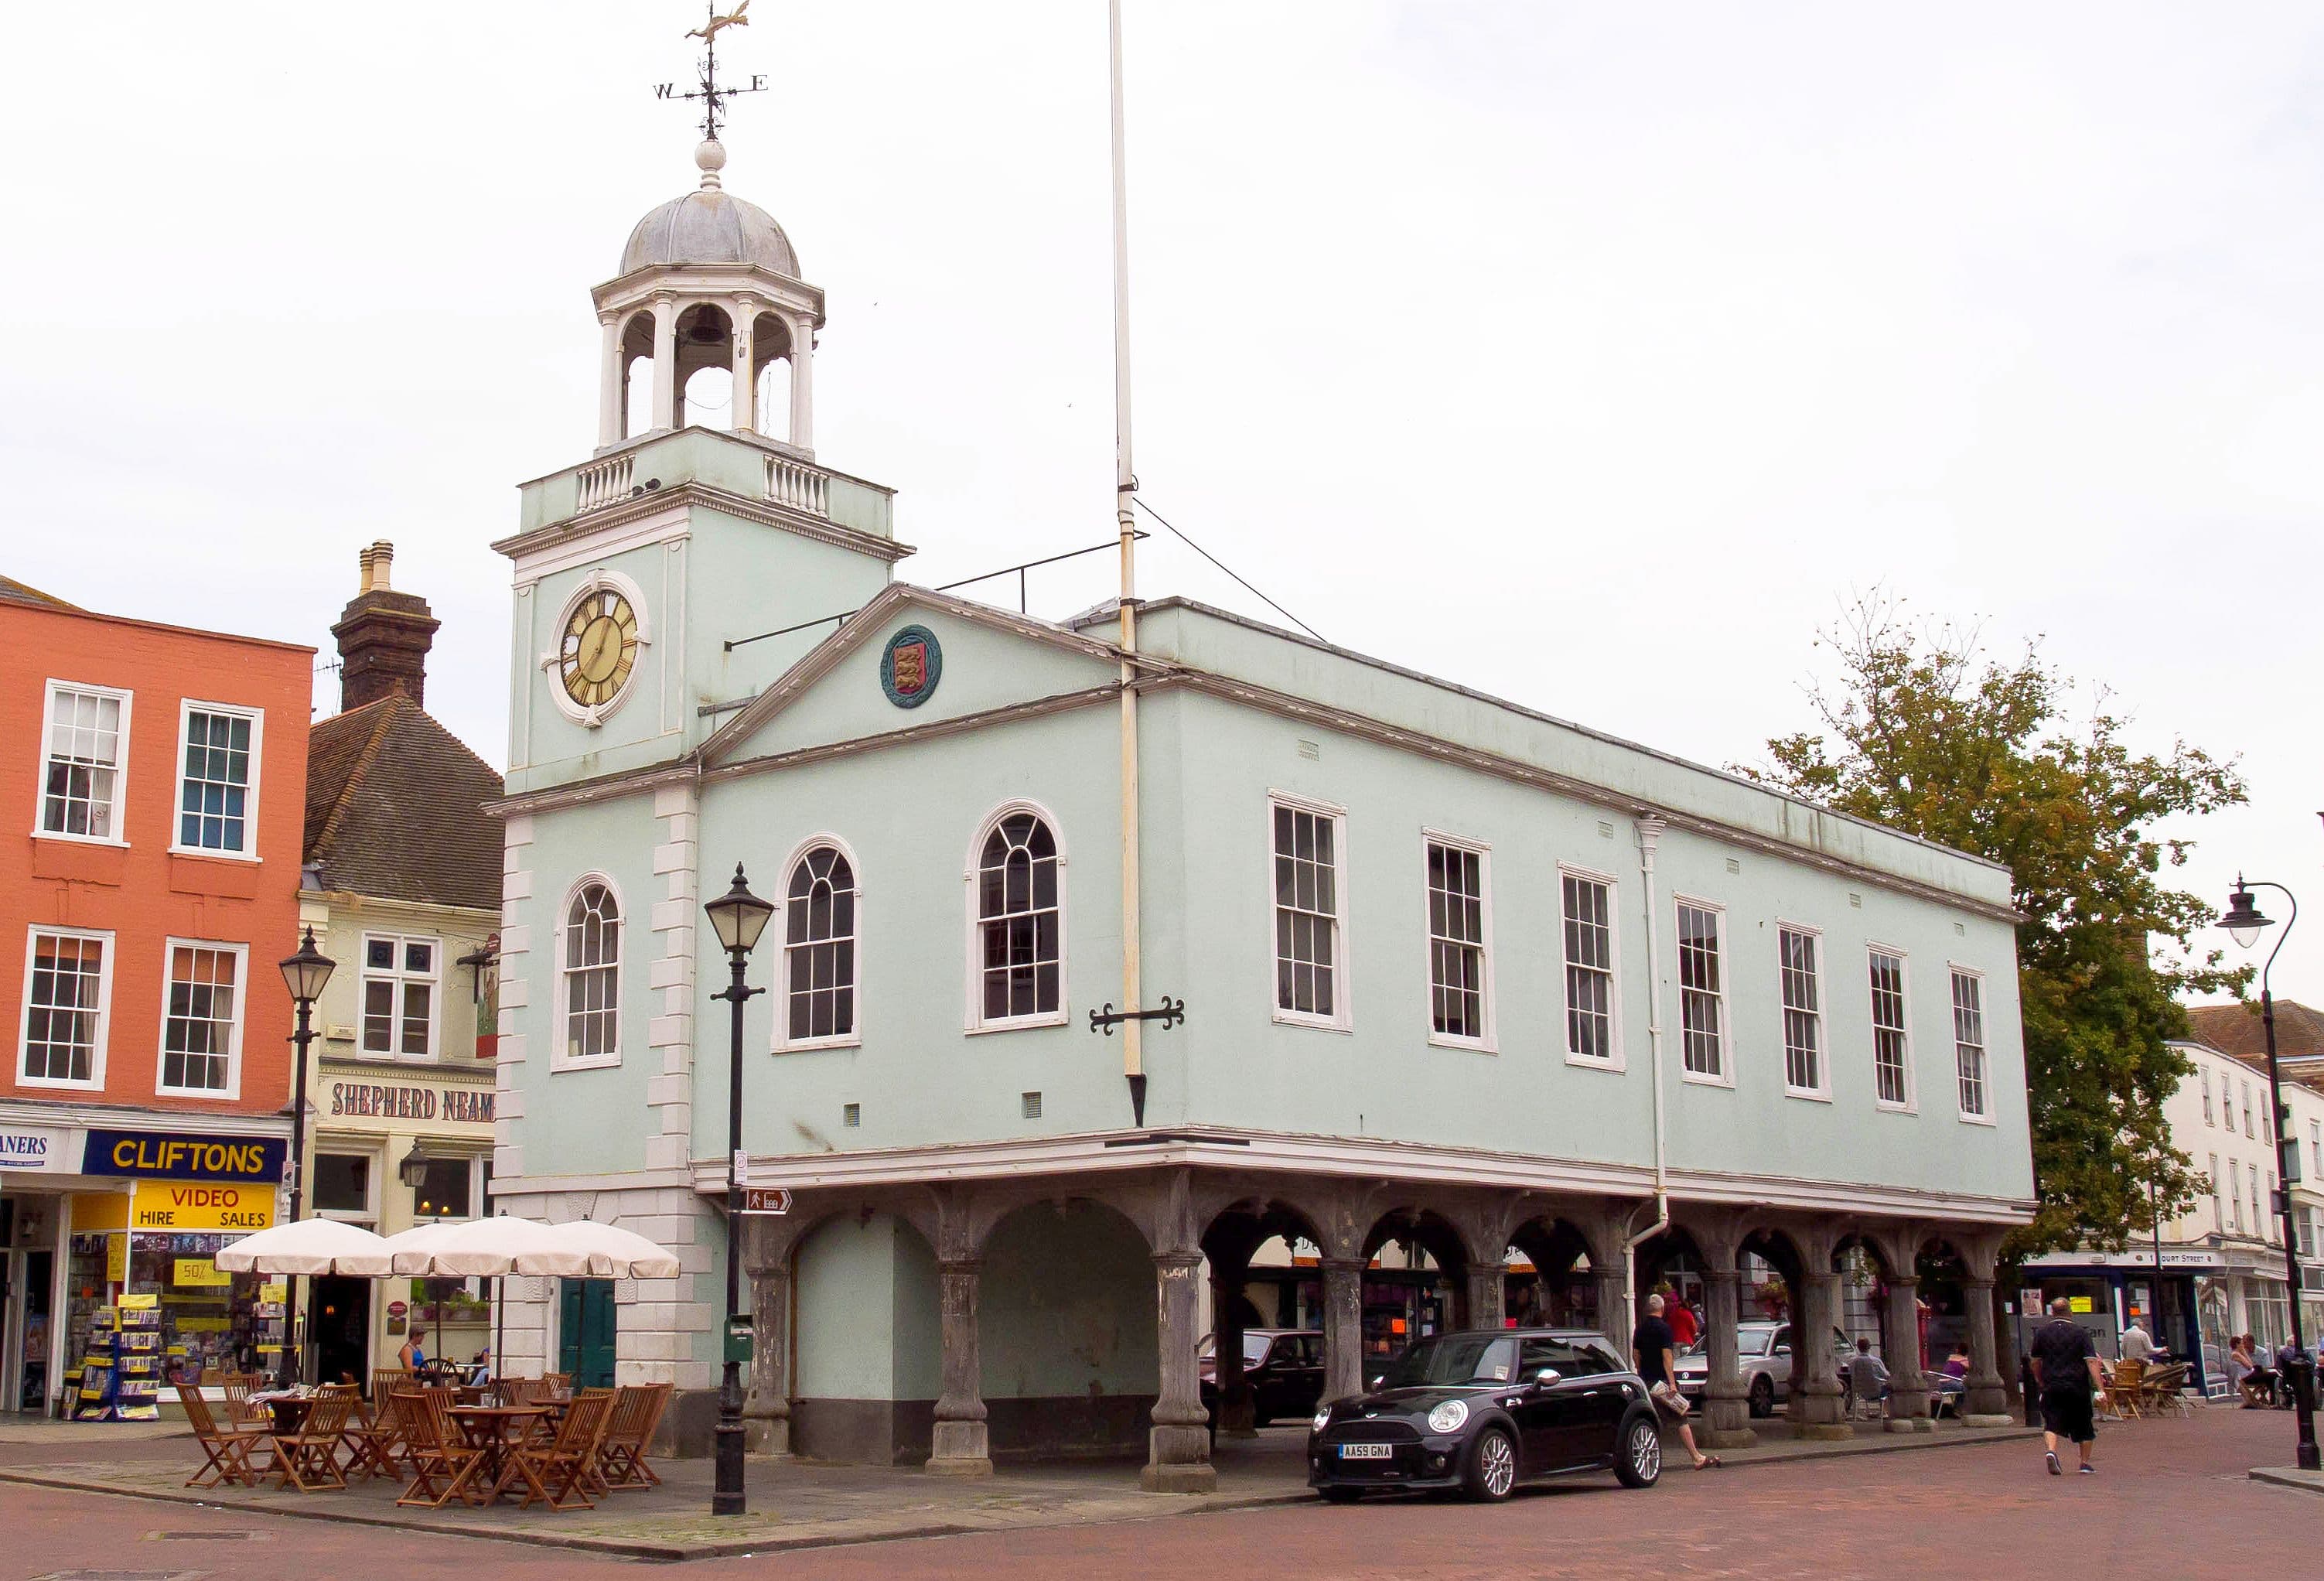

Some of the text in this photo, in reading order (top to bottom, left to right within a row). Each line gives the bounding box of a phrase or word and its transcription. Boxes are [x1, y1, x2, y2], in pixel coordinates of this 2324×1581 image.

[654, 82, 674, 100] W
[750, 74, 769, 91] E
[331, 1082, 437, 1120] SHEPHERD
[112, 1139, 266, 1174] CLIFTONS
[171, 1187, 240, 1207] VIDEO
[140, 1211, 266, 1227] HIRE SALES
[1346, 1445, 1391, 1456] AA59 GNA
